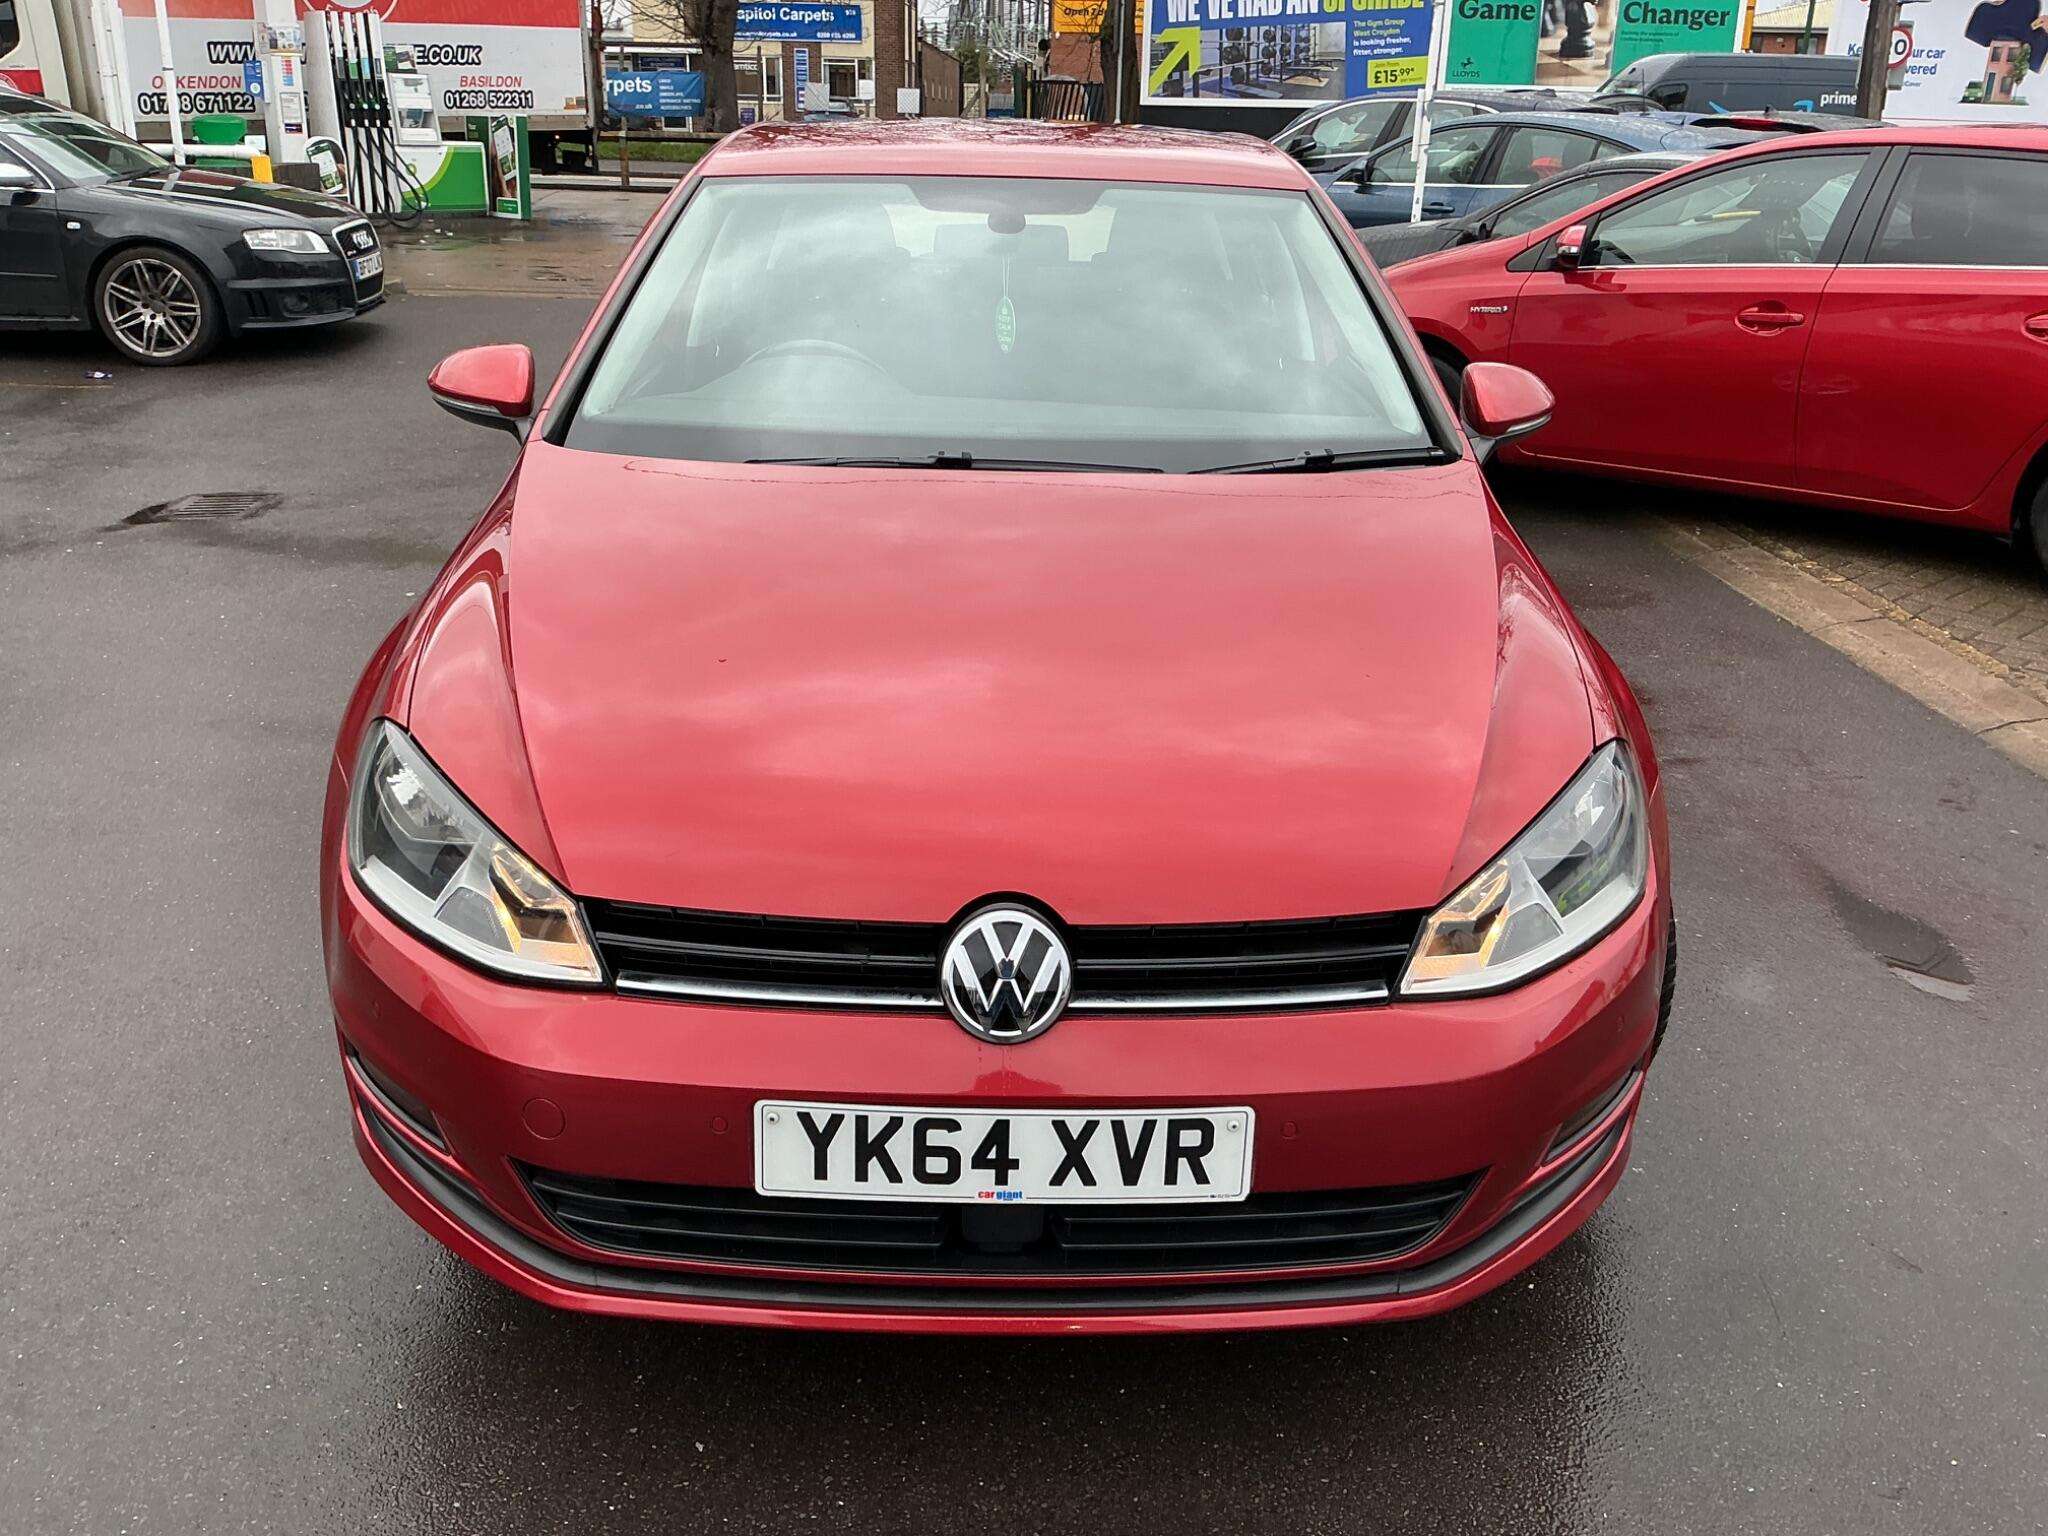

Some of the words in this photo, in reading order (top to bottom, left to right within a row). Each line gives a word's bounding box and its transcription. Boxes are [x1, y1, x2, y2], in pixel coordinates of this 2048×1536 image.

[736, 7, 775, 23] apitol
[779, 7, 835, 24] Carpets
[1458, 0, 1536, 21] Game
[1623, 0, 1731, 31] Changer
[1384, 19, 1405, 27] Group
[1360, 39, 1385, 47] looking
[1927, 49, 1946, 58] car
[1452, 70, 1480, 78] LLOYDS
[1905, 64, 1938, 75] vered
[152, 76, 242, 89] OKENDON
[459, 76, 522, 88] BASILDON
[606, 77, 652, 96] rpets
[139, 93, 191, 113] 0178
[194, 93, 255, 113] 671122
[444, 90, 486, 109] 01268
[488, 90, 534, 109] 522311
[1820, 91, 1857, 107] prime
[796, 1111, 1020, 1186] YK64
[1048, 1117, 1215, 1187] XVR
